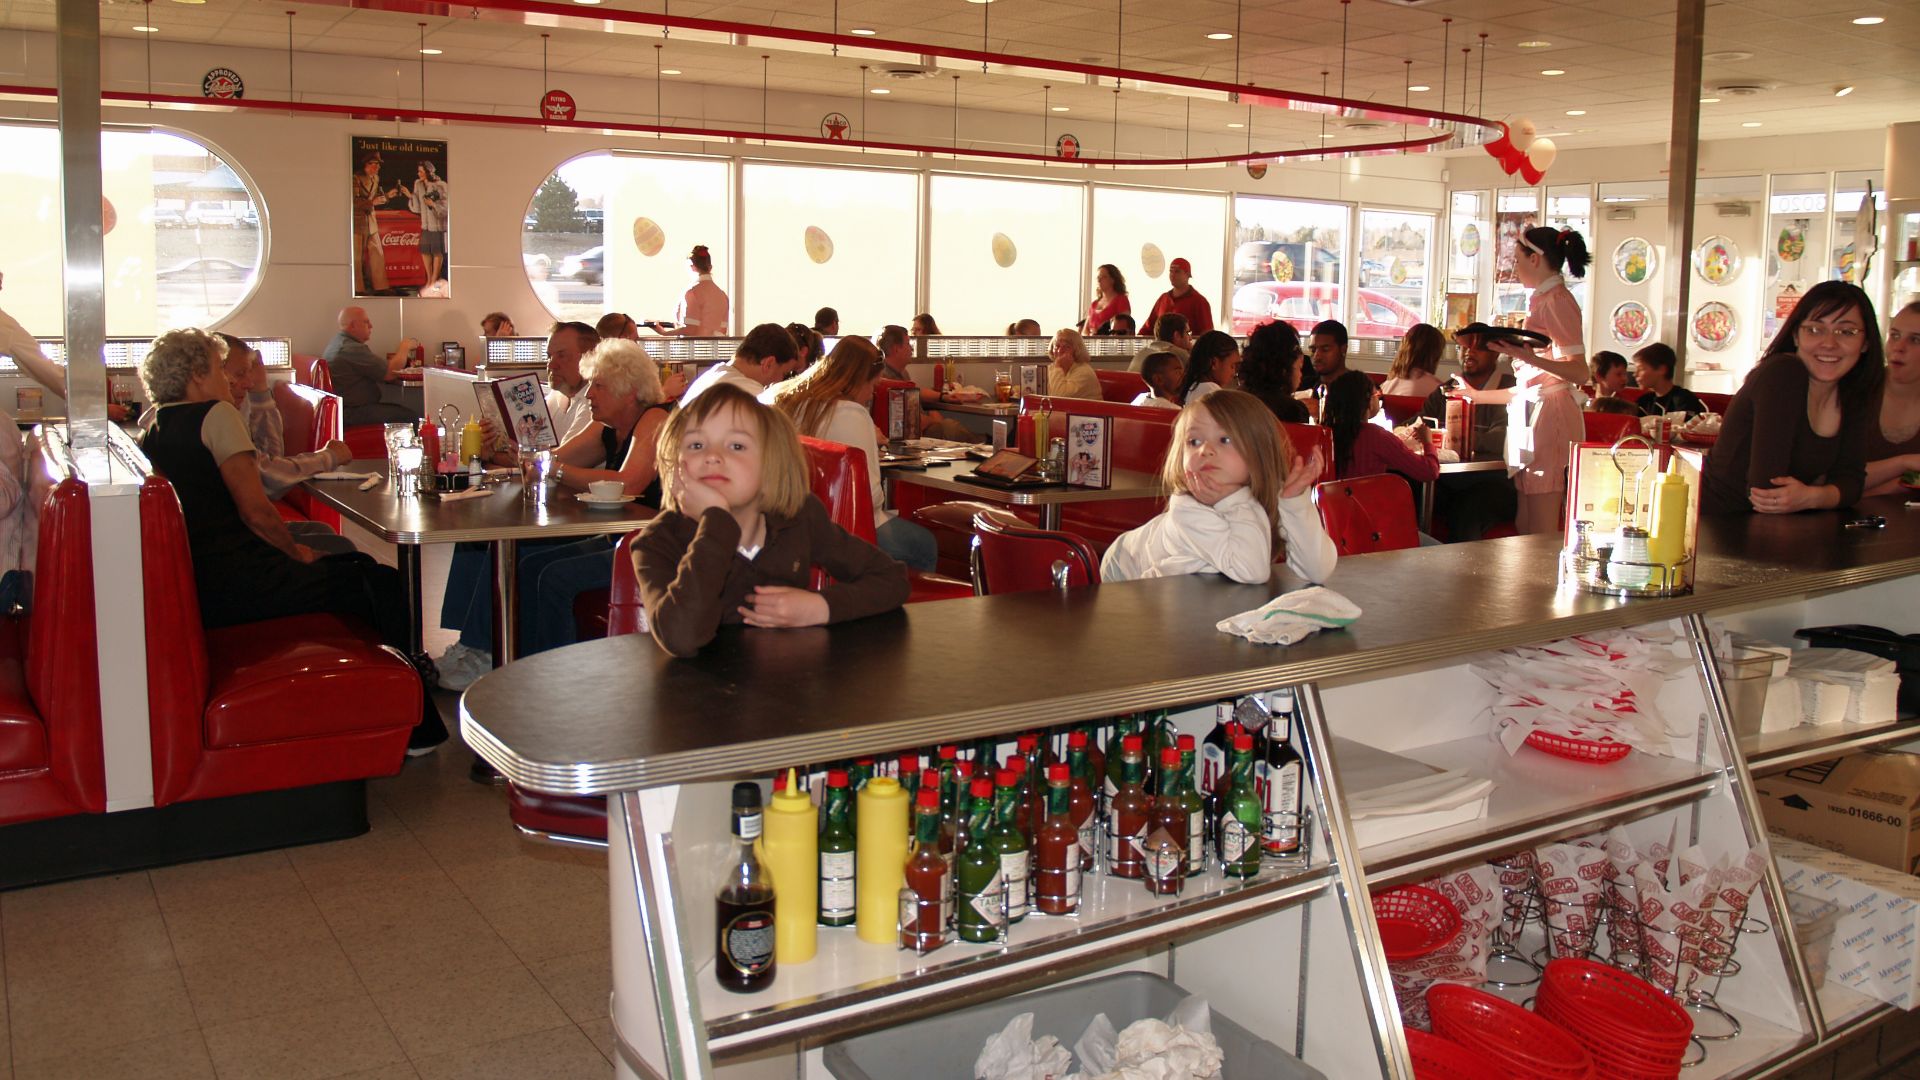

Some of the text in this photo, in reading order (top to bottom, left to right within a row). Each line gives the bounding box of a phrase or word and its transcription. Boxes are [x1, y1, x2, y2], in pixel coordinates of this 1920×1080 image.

[207, 70, 240, 82] APPROVED
[382, 141, 398, 151] like
[399, 143, 413, 152] old
